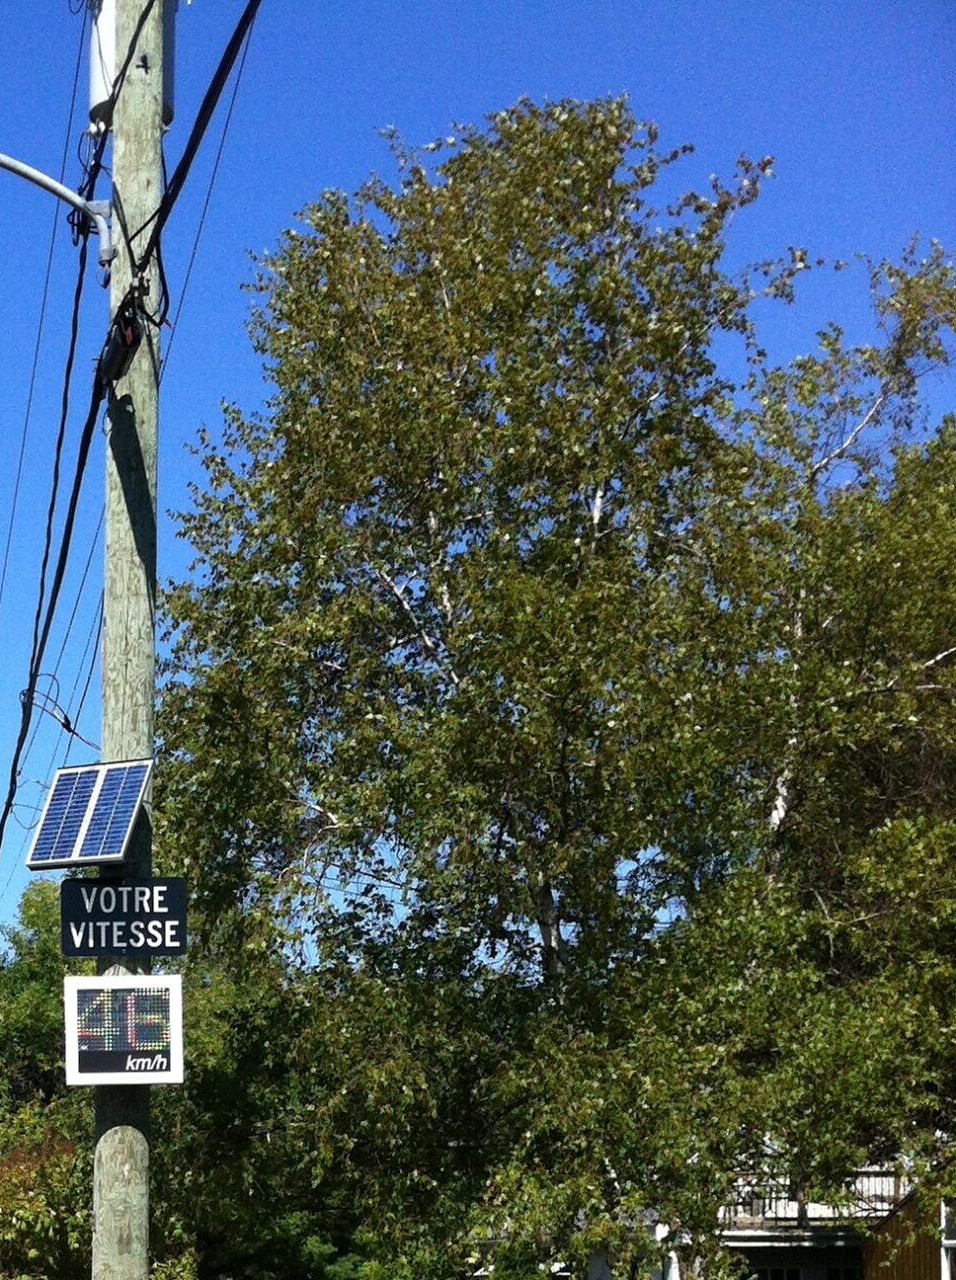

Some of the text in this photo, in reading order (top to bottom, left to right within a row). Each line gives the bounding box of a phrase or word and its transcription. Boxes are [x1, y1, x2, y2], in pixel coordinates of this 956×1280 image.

[81, 886, 168, 913] VOTRE
[70, 921, 180, 948] VITESSE
[125, 1054, 168, 1071] km/h
